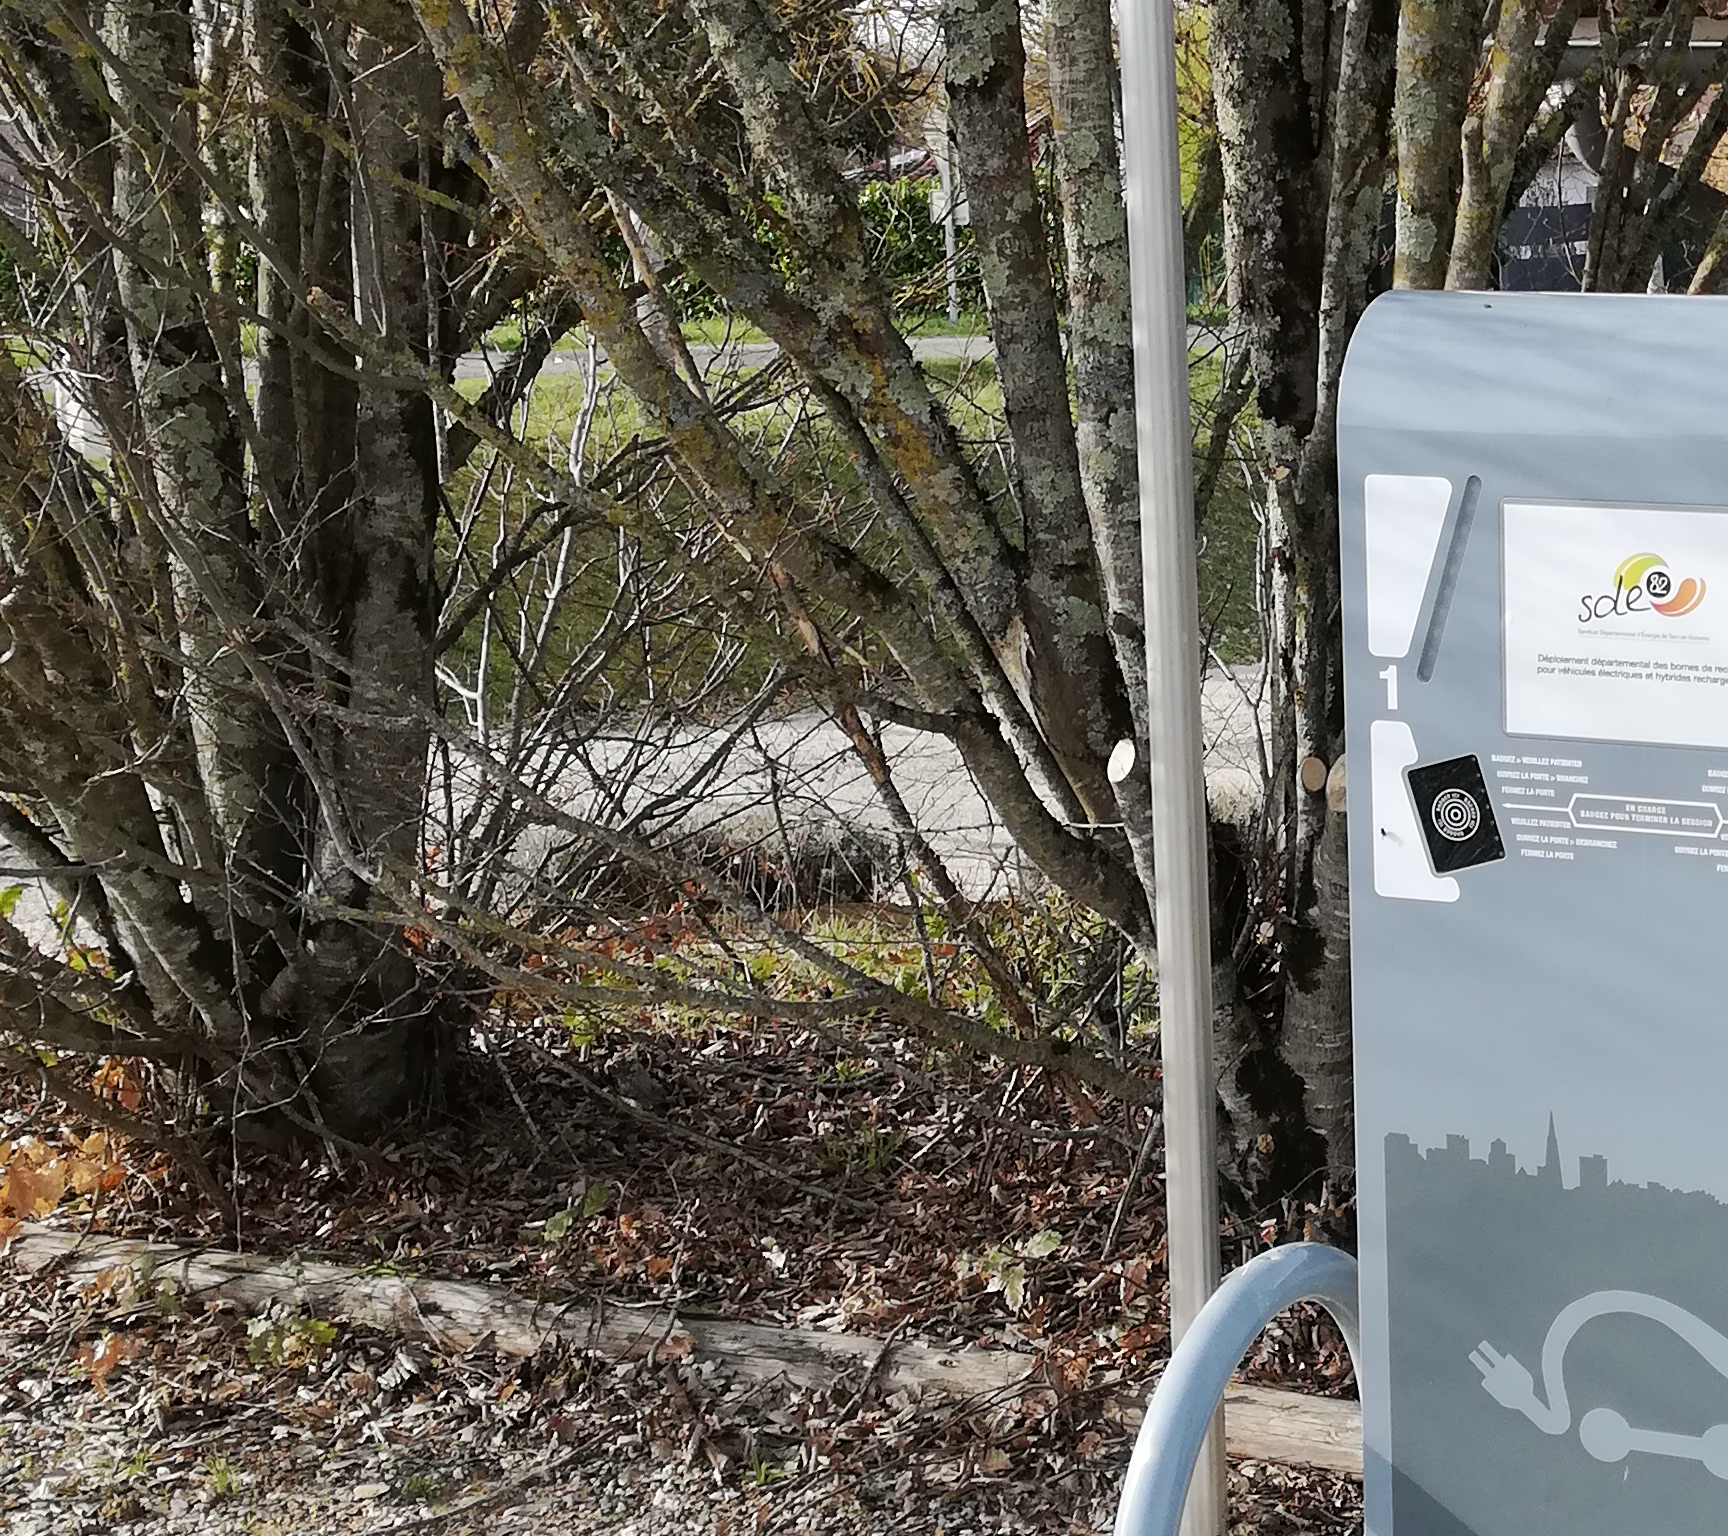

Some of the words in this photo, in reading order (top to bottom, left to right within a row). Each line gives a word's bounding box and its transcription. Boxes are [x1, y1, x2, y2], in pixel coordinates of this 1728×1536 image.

[1578, 574, 1652, 623] sde
[1649, 573, 1668, 594] 82
[1538, 654, 1589, 666] Déploiement
[1591, 657, 1650, 670] départemental
[1653, 660, 1668, 670] des
[1670, 662, 1699, 673] bornes
[1701, 664, 1713, 673] de
[1537, 667, 1556, 675] pour
[1558, 666, 1596, 677] véhicules
[1598, 669, 1643, 681] électriques
[1645, 671, 1653, 680] et
[1655, 671, 1691, 684] hybrides
[1378, 665, 1399, 710] 1
[1521, 772, 1529, 780] LA
[1530, 773, 1550, 781] PORTE
[1526, 788, 1535, 796] LA
[1535, 788, 1555, 797] PORTE
[1625, 804, 1636, 812] EN
[1638, 805, 1666, 814] CHARGE
[1580, 809, 1609, 820] BADGEZ
[1610, 812, 1630, 821] POUR
[1632, 814, 1669, 825] TERMINER
[1670, 816, 1680, 825] LA
[1681, 817, 1713, 828] SESSION
[1550, 837, 1569, 845] PORTE
[1546, 851, 1554, 859] LA
[1555, 852, 1574, 860] PORTE
[1700, 848, 1709, 856] LA
[1709, 849, 1728, 858] PORTE
